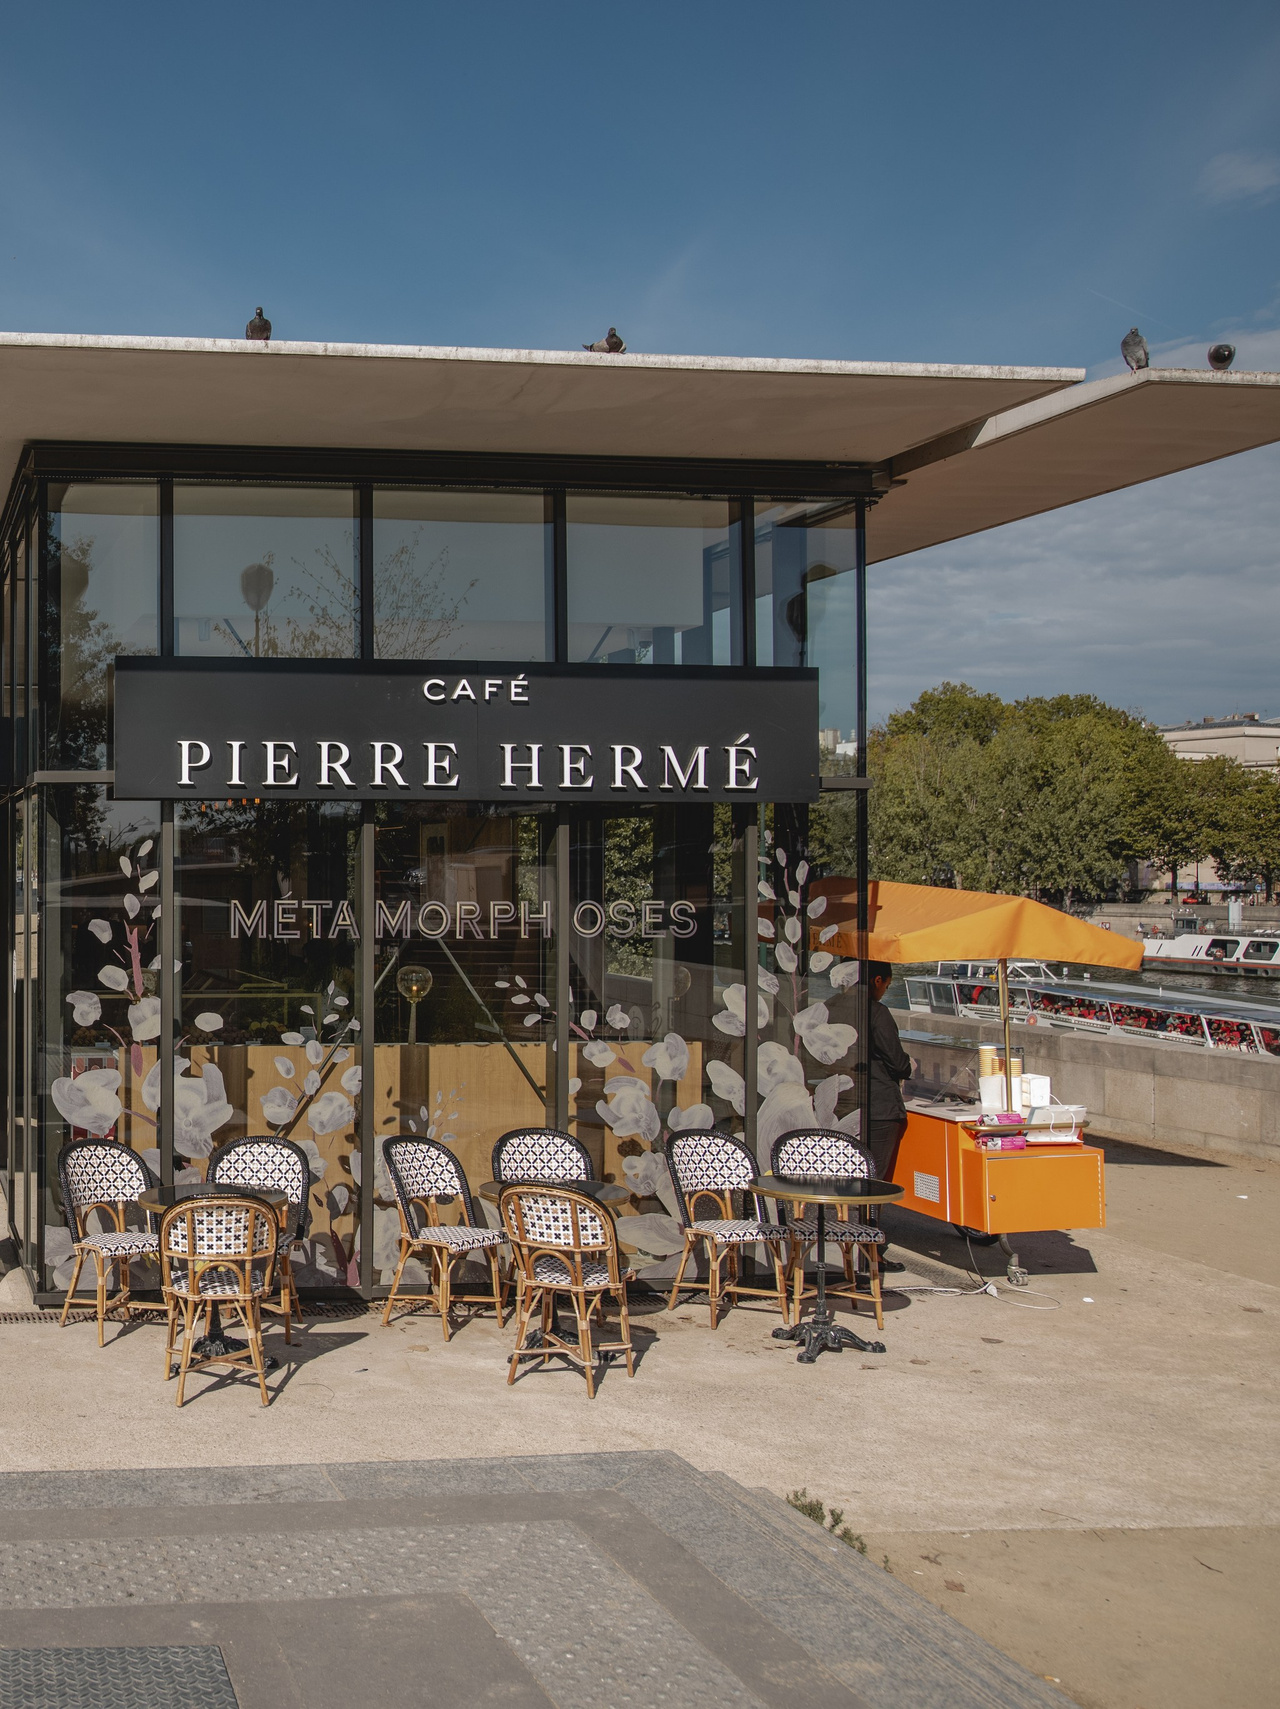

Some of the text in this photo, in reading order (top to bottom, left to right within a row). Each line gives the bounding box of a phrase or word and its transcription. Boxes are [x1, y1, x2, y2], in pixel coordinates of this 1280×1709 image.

[423, 673, 529, 702] CAFÉ
[177, 733, 759, 789] PIERRE HERMÉ
[231, 891, 698, 941] MÉTA MORPH OSES
